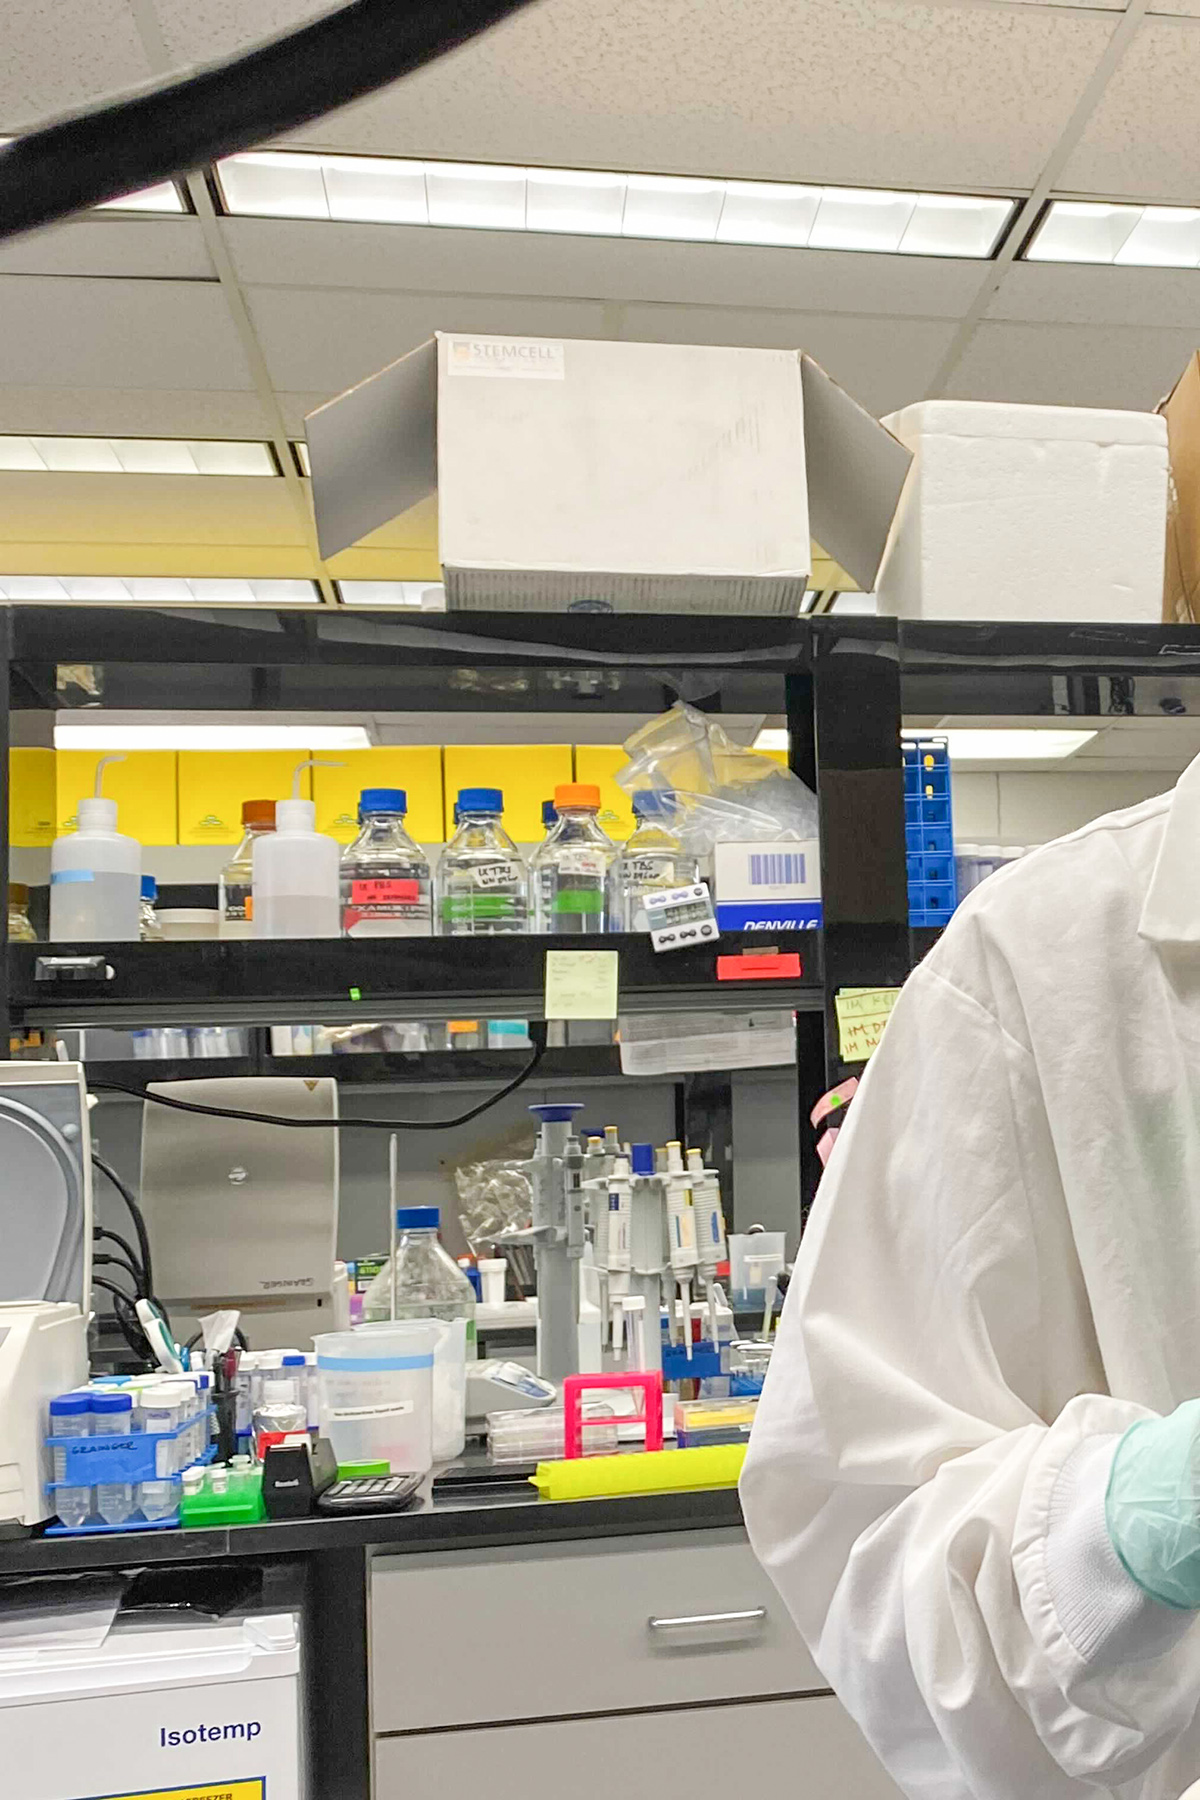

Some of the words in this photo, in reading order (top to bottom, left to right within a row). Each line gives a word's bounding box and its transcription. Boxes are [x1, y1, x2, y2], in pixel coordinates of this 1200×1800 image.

[473, 343, 555, 360] STEMCELL
[71, 1440, 138, 1455] GRAINGER
[160, 1721, 261, 1748] Isotemp
